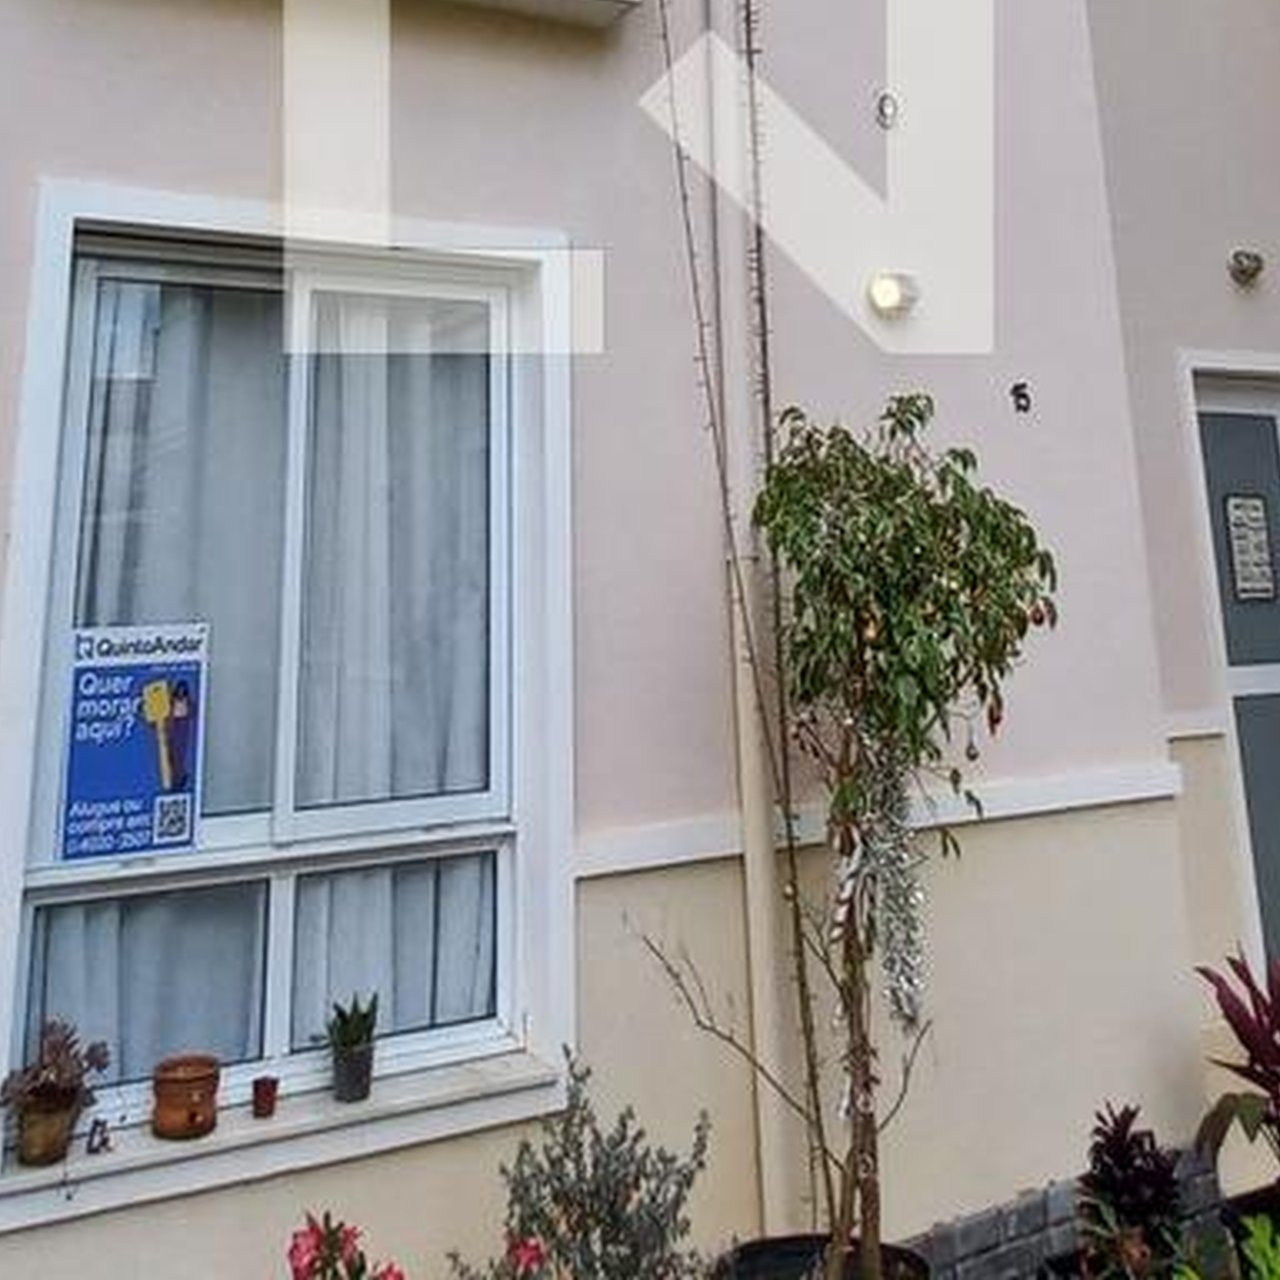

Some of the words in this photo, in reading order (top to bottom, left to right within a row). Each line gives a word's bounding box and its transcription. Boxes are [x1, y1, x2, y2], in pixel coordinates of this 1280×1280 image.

[97, 634, 203, 657] QuintoAndar
[79, 672, 134, 696] Quer
[76, 696, 142, 719] morar
[75, 714, 134, 745] aqui?
